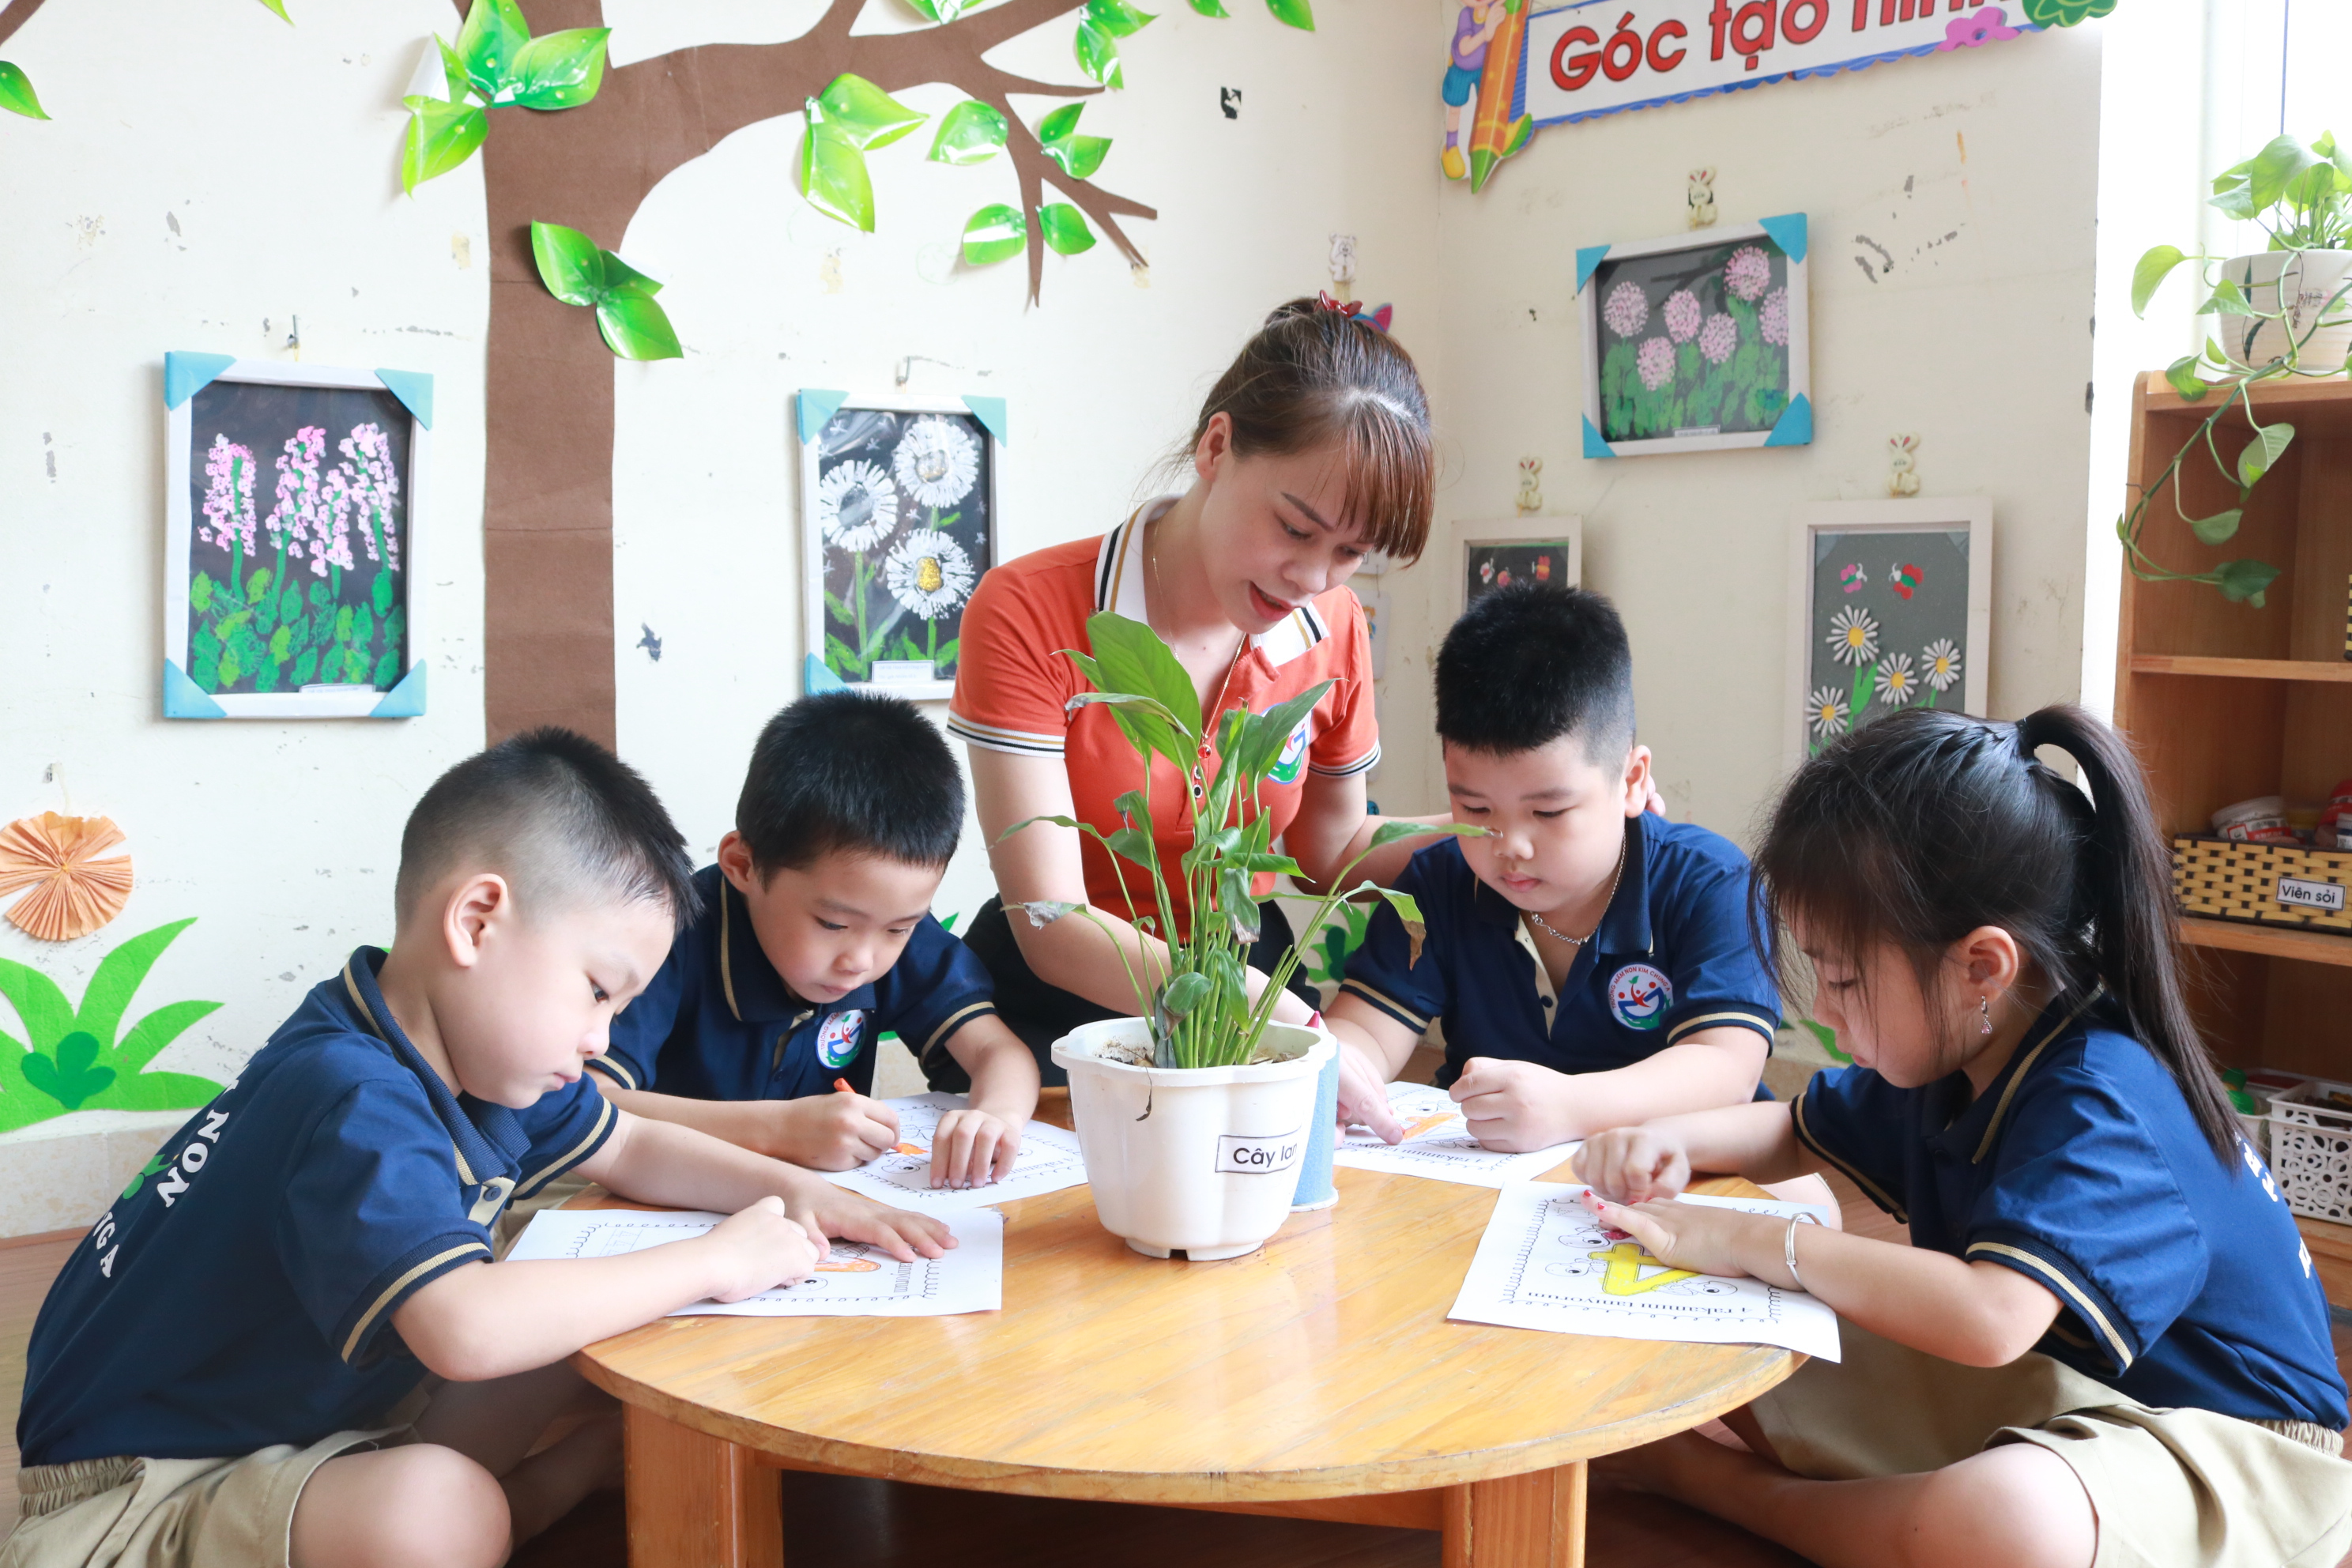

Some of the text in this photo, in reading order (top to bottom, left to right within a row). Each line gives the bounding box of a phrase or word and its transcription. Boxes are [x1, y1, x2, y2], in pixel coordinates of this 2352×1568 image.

[1549, 12, 1688, 92] Góc
[1709, 0, 1831, 71] tạo
[2282, 884, 2335, 904] Viên sỏi
[1649, 971, 1668, 987] CHUNG
[157, 1109, 229, 1208] NON
[1233, 1147, 1276, 1168] Cây
